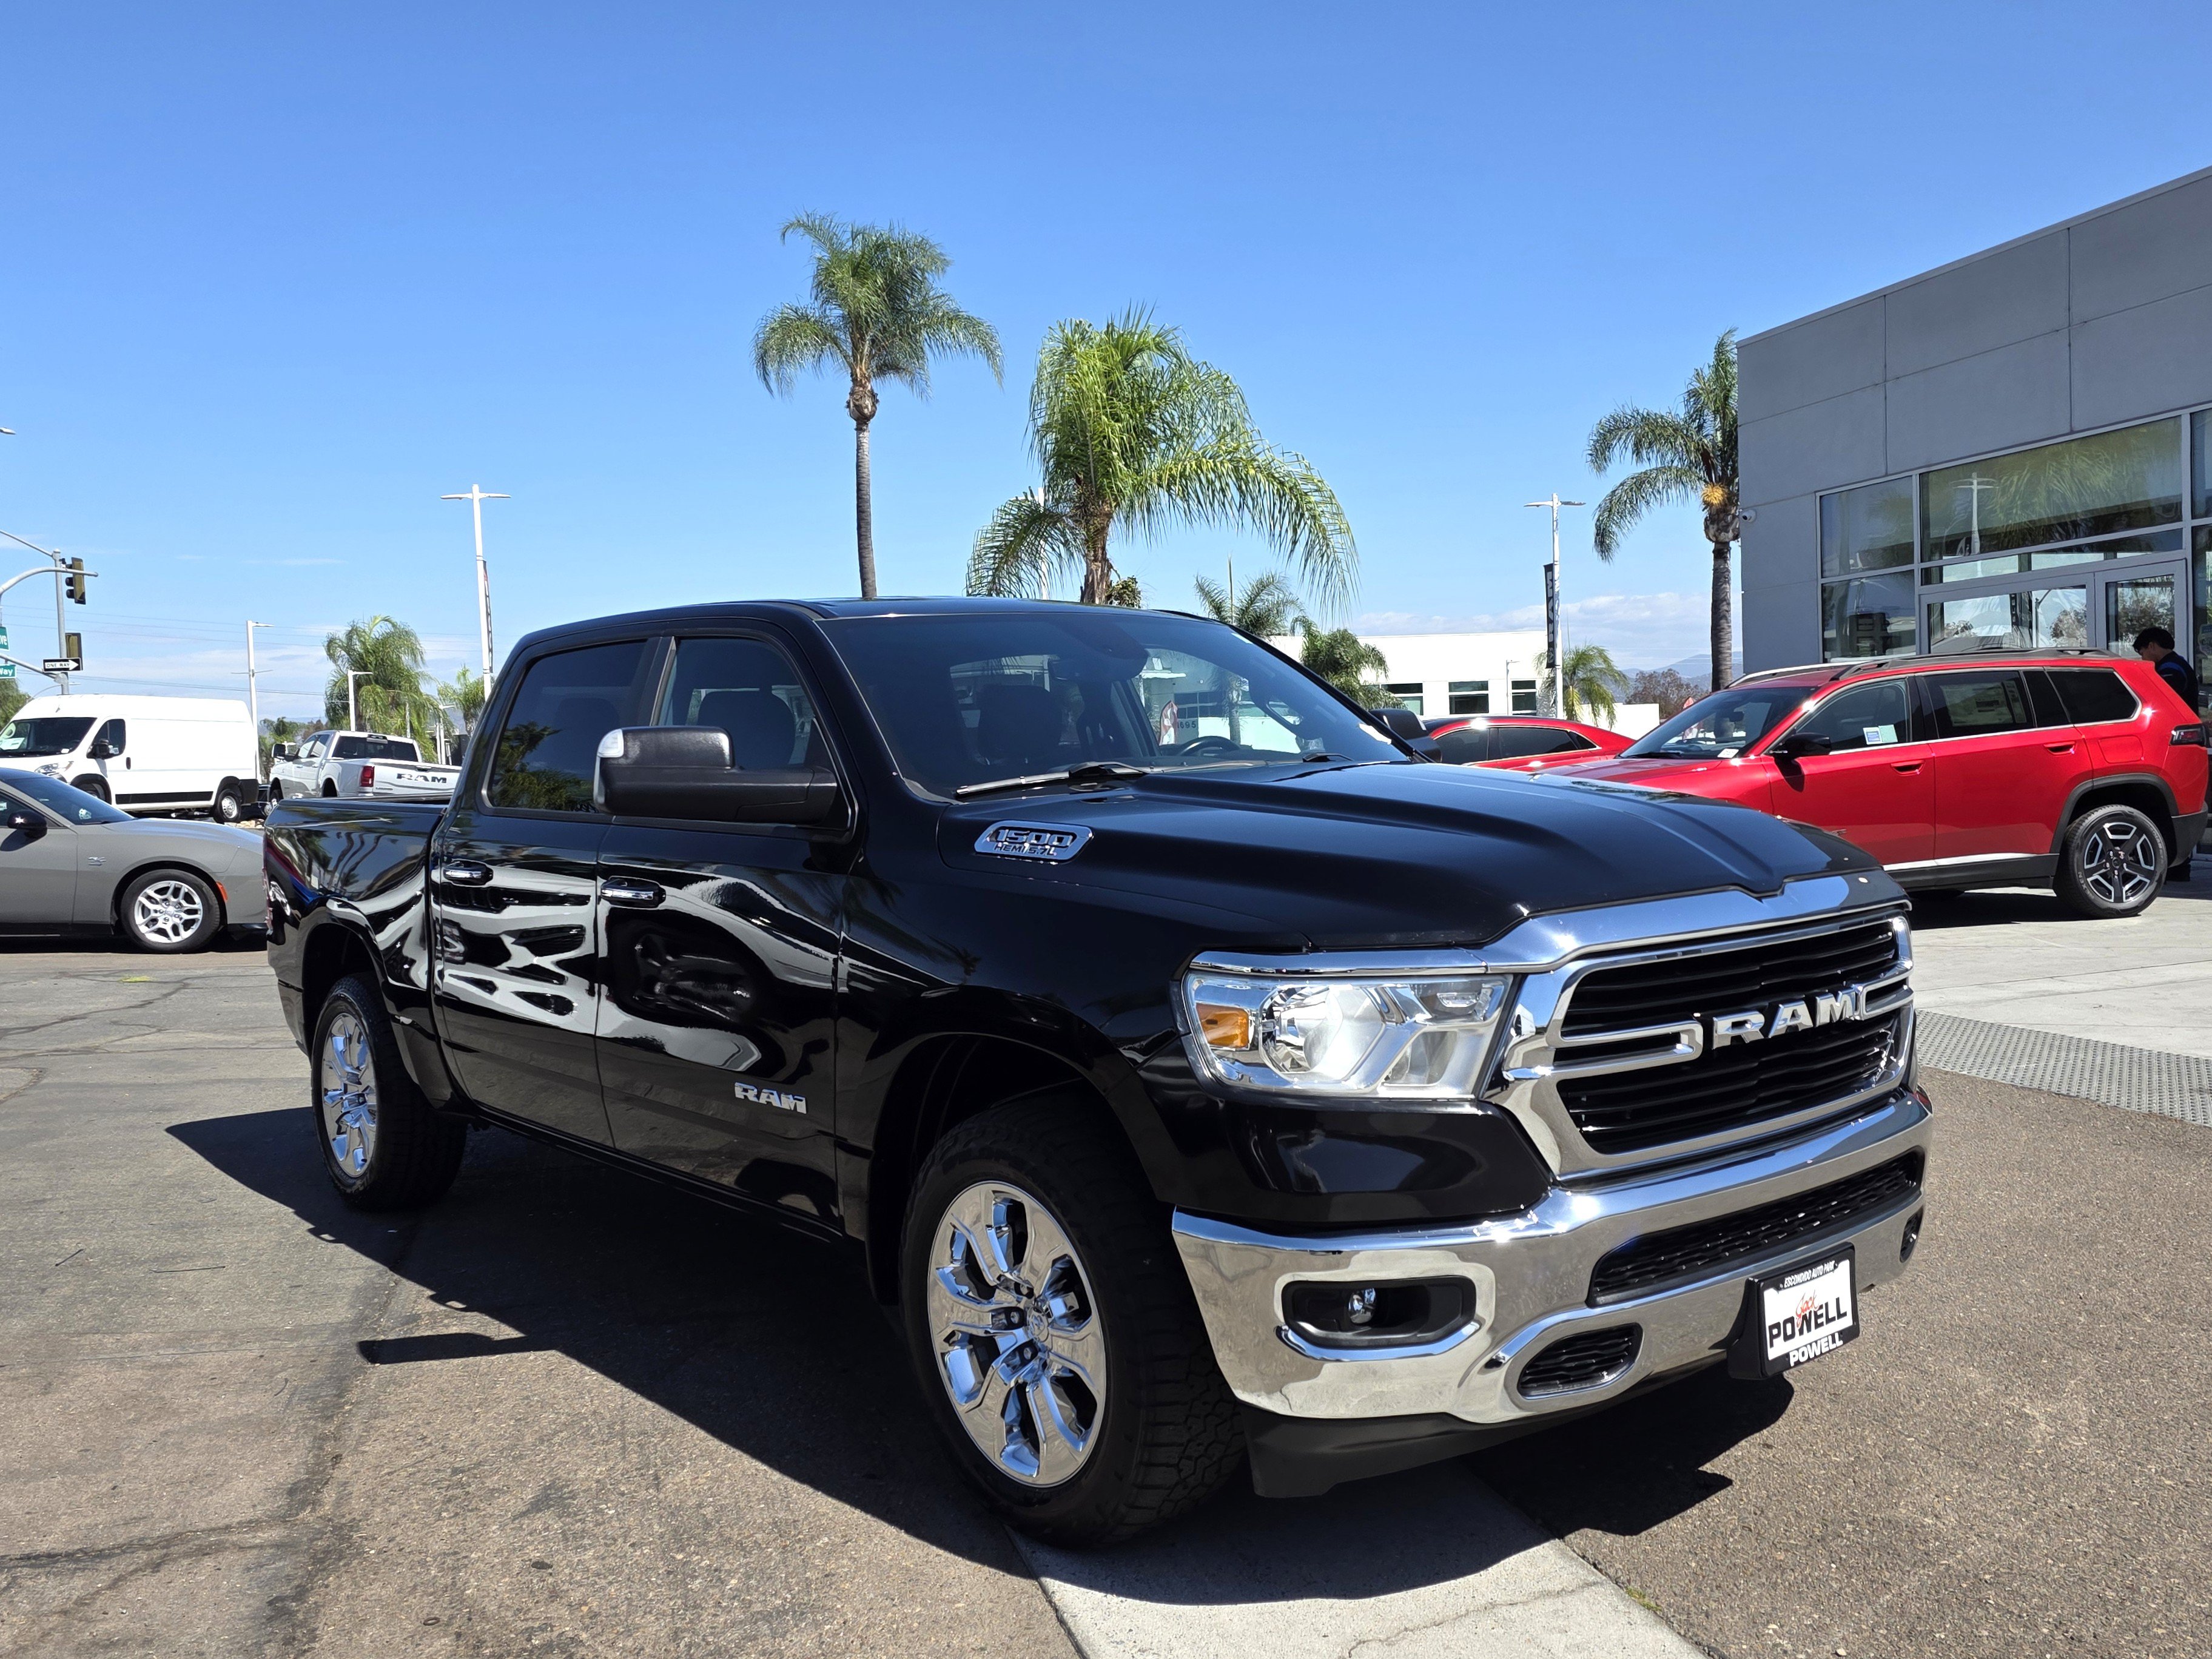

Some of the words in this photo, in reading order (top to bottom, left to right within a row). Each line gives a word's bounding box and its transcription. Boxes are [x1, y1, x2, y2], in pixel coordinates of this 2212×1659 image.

[396, 773, 447, 784] RAM
[993, 843, 1027, 853] HEMI
[996, 829, 1074, 847] 1500
[1712, 986, 1857, 1050] RAM
[735, 1082, 807, 1114] RAM
[1784, 1270, 1812, 1288] ESCONDIDO
[1812, 1265, 1824, 1279] AUTO
[1824, 1260, 1835, 1274] PARK
[1768, 1297, 1847, 1348] POWELL
[1795, 1290, 1820, 1328] Jack
[1789, 1331, 1844, 1367] POWELL
